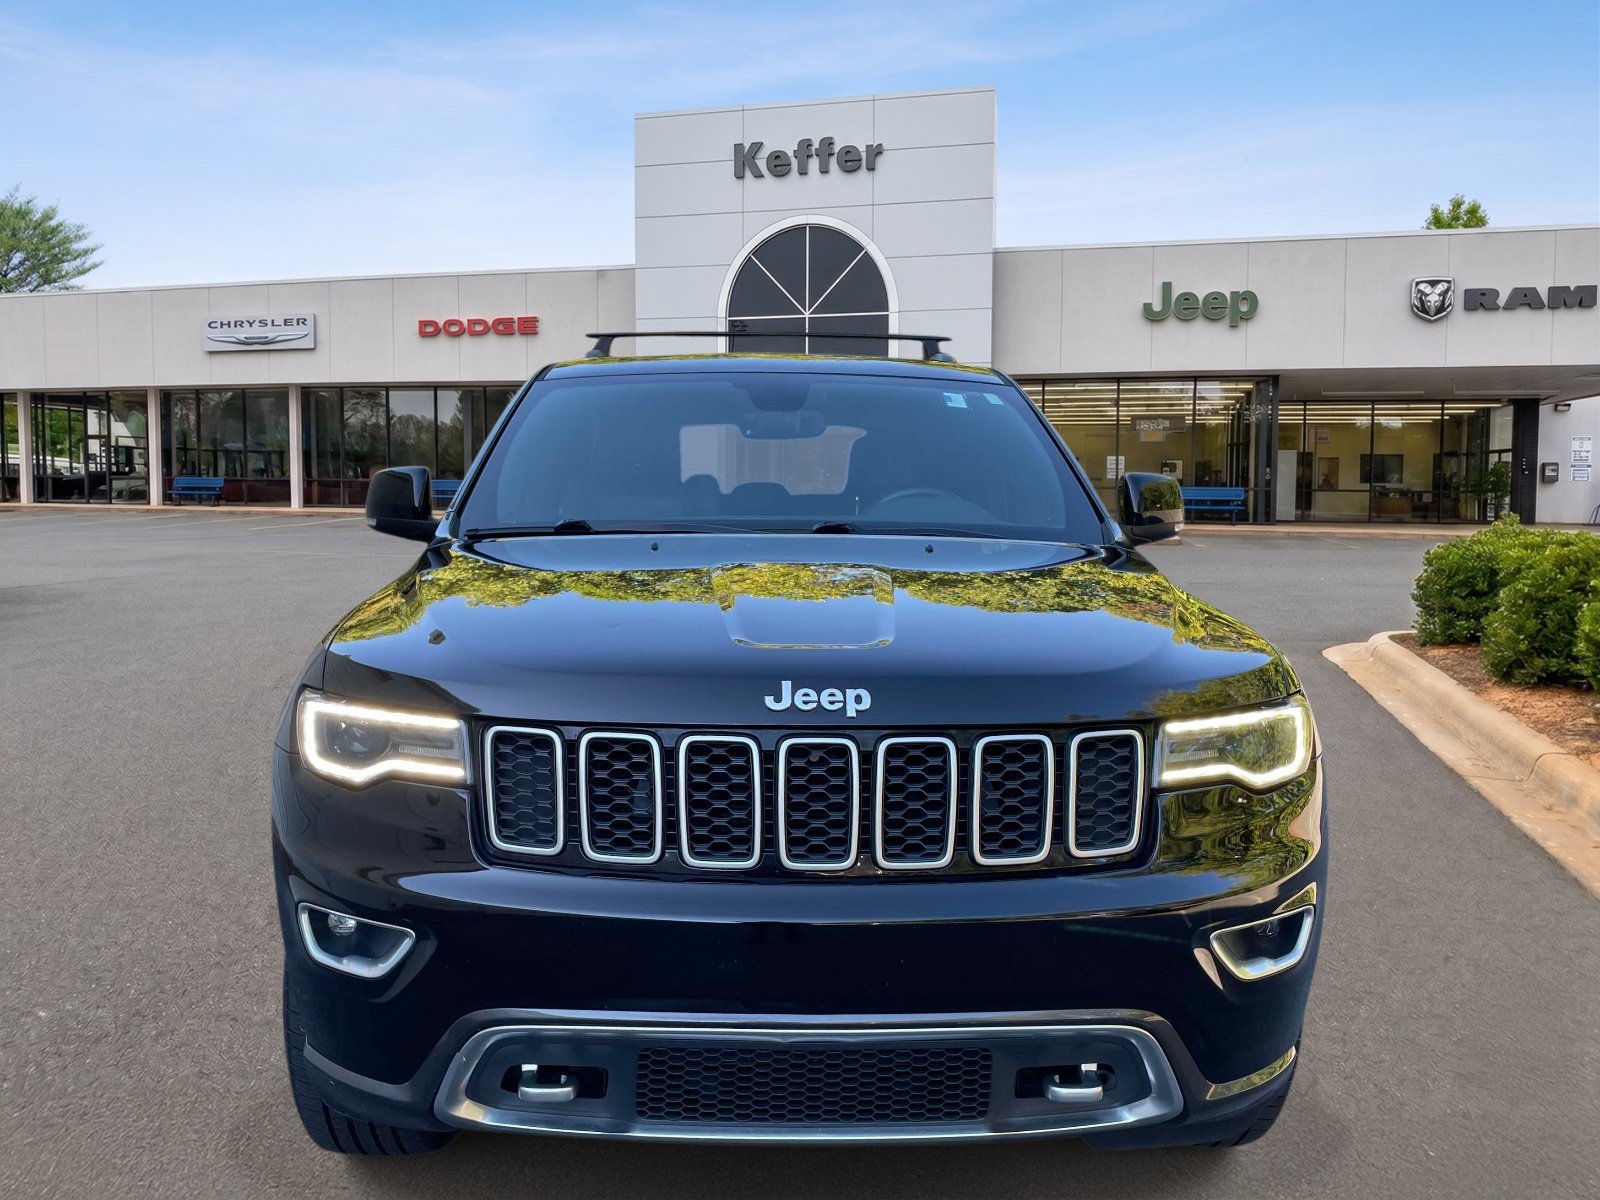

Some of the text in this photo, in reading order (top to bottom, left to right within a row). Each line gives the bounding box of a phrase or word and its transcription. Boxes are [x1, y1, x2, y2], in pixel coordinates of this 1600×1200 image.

[734, 137, 883, 178] Keffer
[1143, 281, 1258, 327] Jeep
[1464, 285, 1597, 310] RAM
[207, 318, 308, 329] CHRYSLER
[418, 317, 538, 336] DODGE
[764, 681, 871, 718] Jeep
